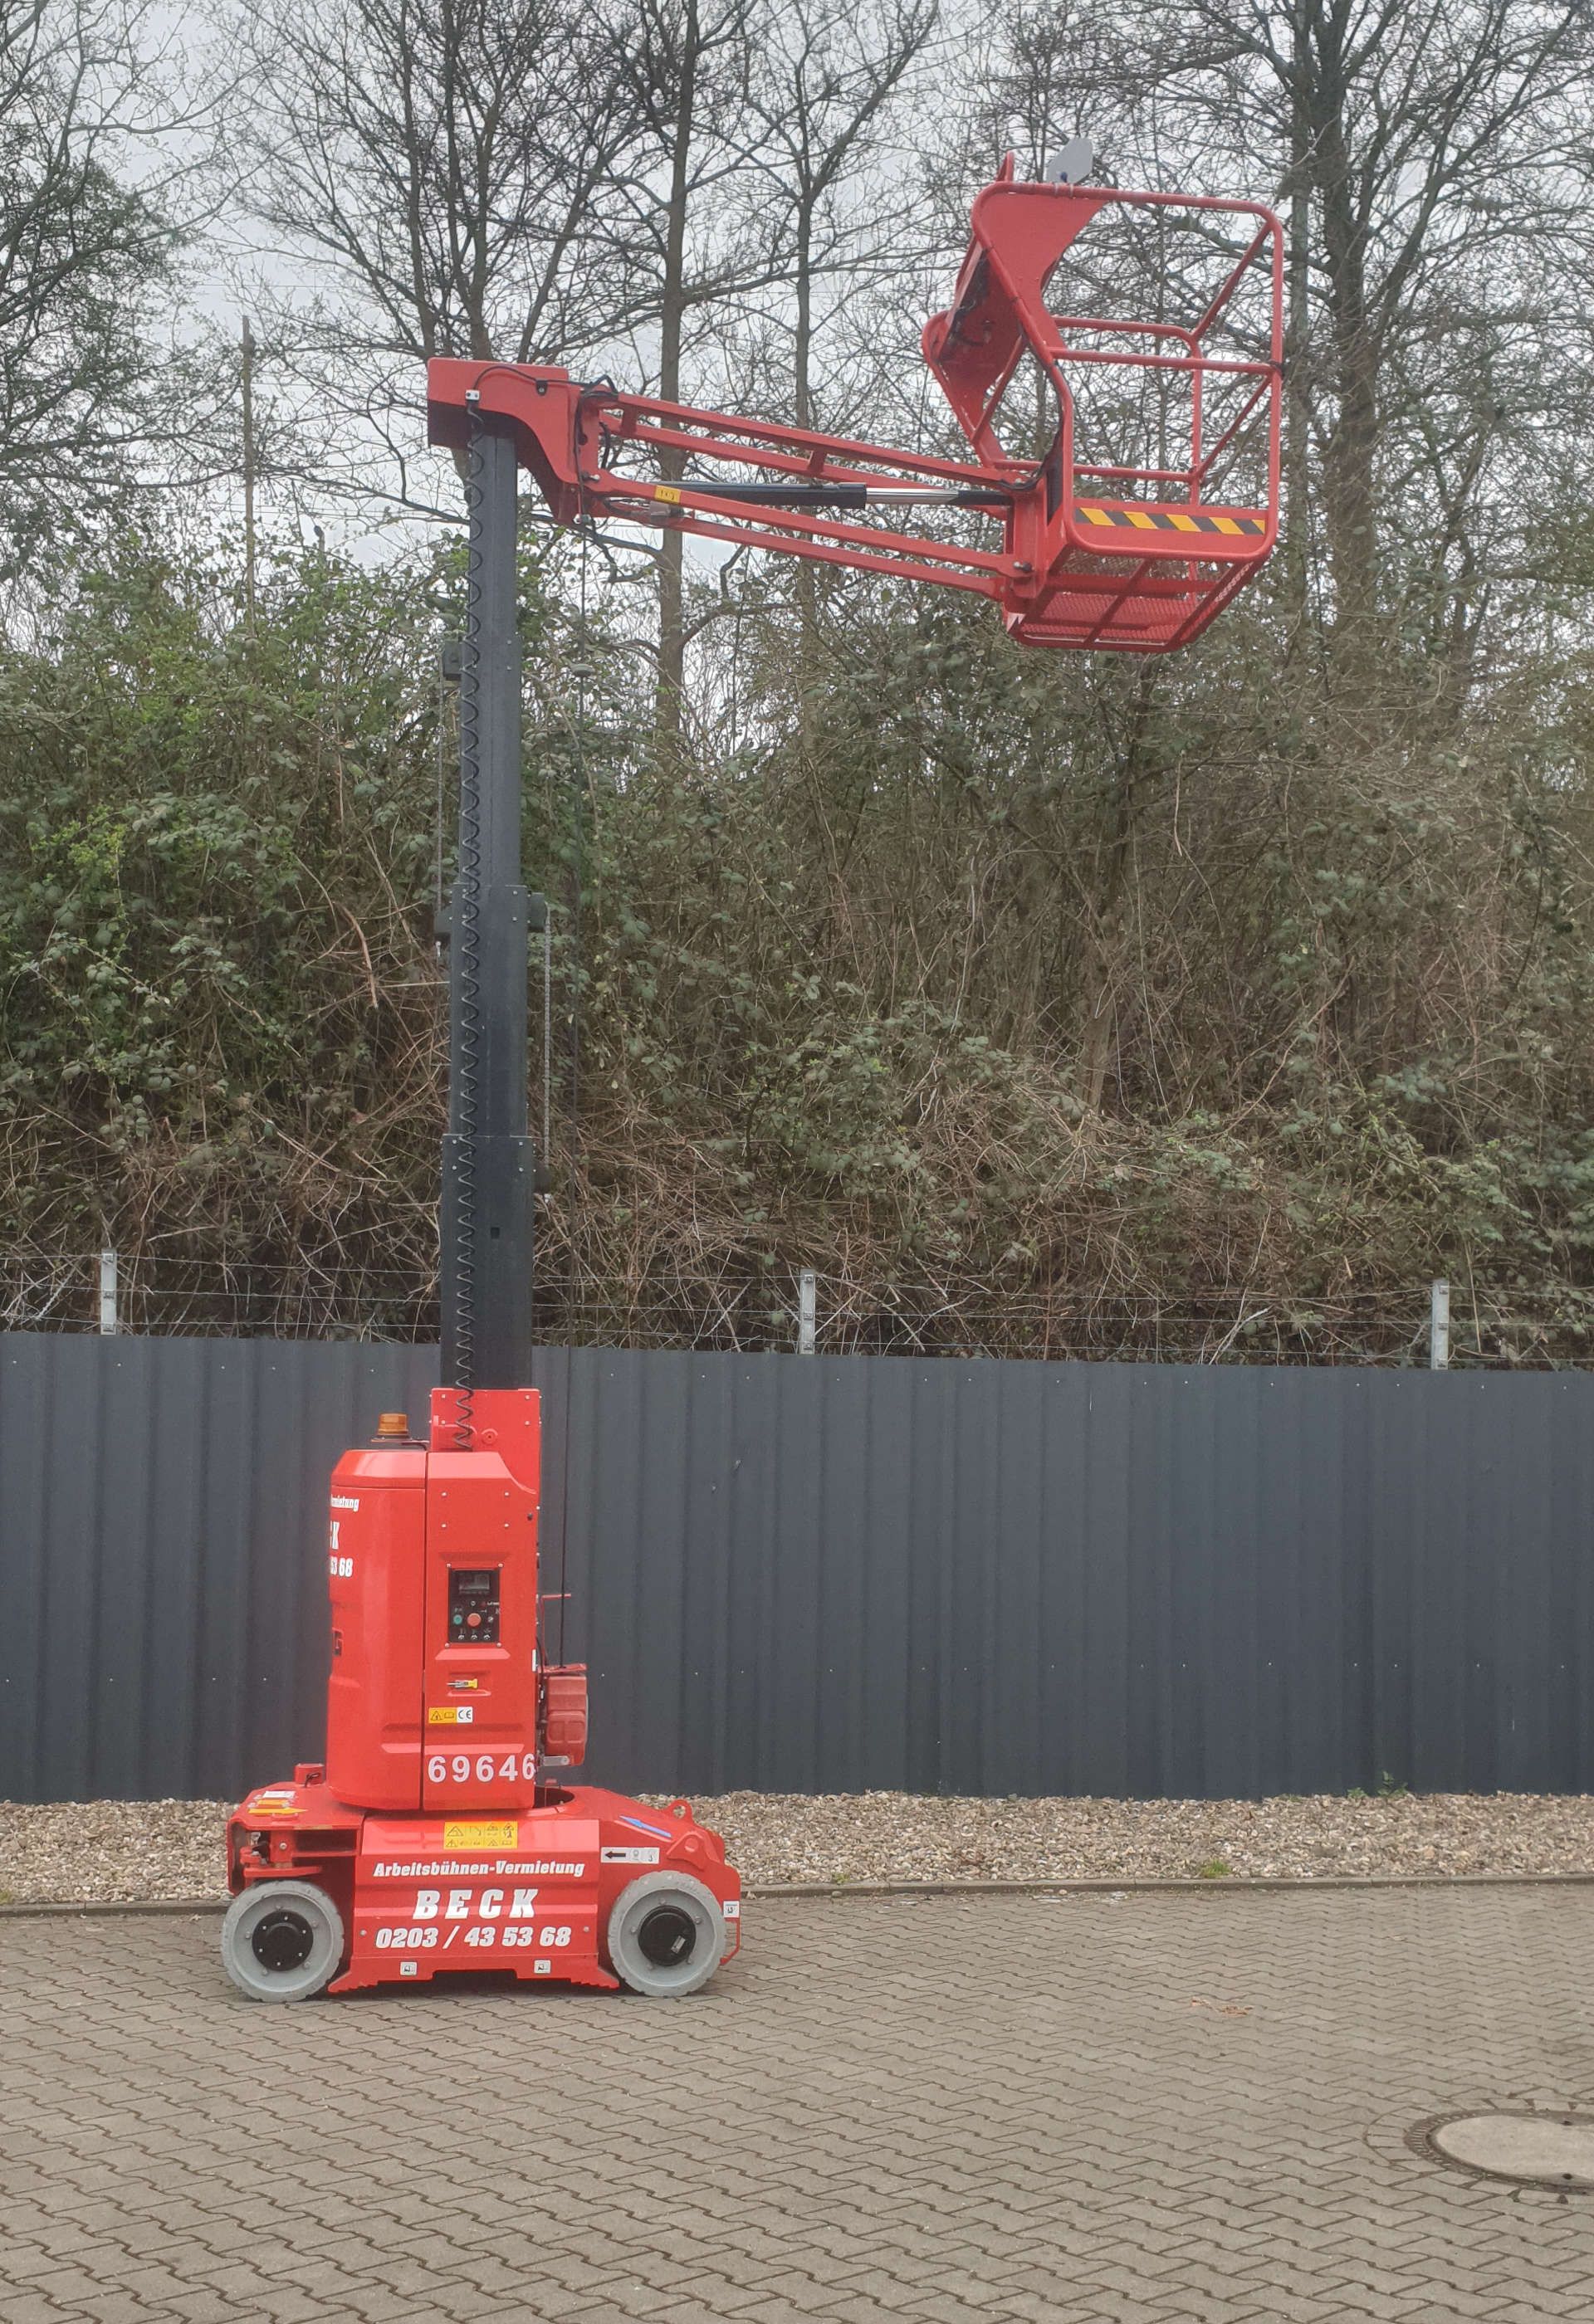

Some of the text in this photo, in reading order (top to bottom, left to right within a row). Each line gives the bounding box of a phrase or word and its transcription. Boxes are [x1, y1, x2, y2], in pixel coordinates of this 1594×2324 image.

[339, 1557, 354, 1577] 68
[457, 1709, 472, 1720] CE
[428, 1753, 535, 1783] 69646
[373, 1859, 586, 1878] Arbeitsbühnen-Vermietung
[412, 1888, 539, 1920] BECK
[374, 1925, 572, 1950] 0203 / 43 53 68
